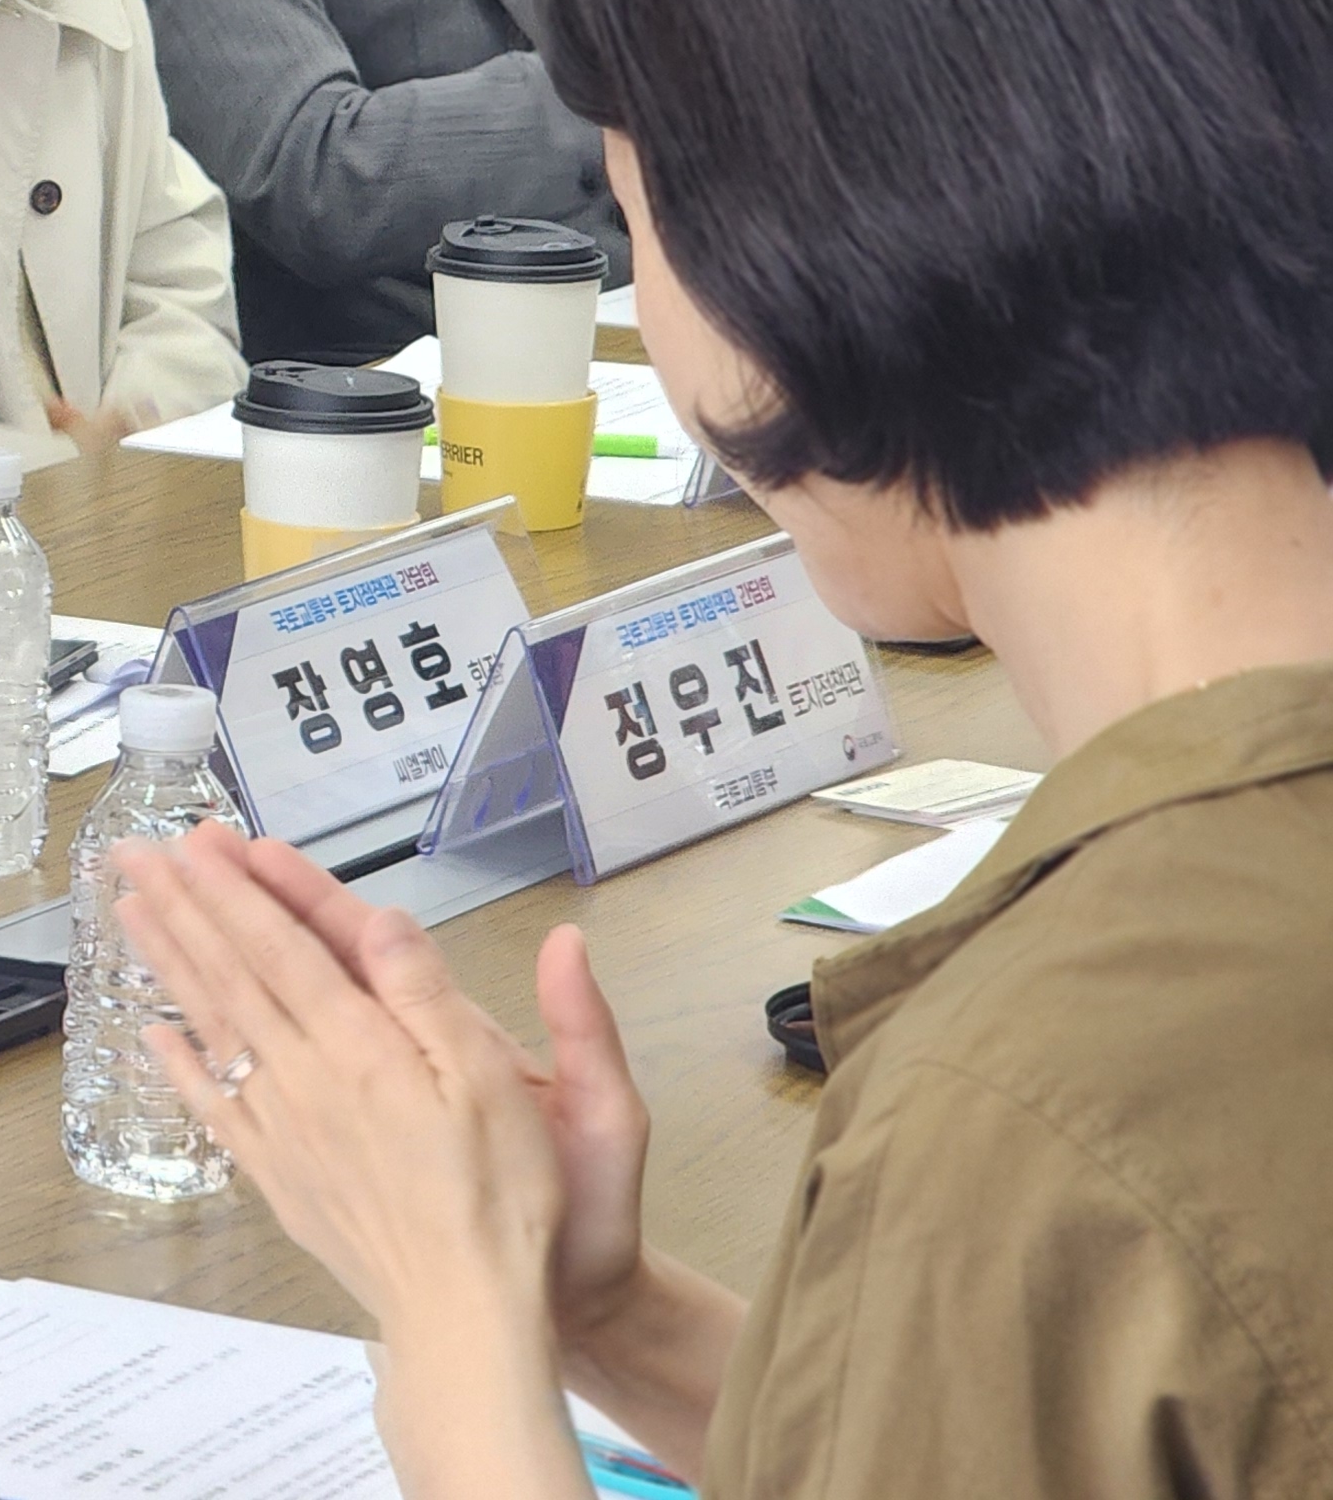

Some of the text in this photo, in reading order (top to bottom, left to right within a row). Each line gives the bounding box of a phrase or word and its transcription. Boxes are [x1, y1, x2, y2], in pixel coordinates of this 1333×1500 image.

[441, 440, 484, 467] ERRIER
[270, 562, 440, 633] 국토교통부 토지정책관 간담회
[615, 575, 776, 649] 국토교통부 토지정책관 간담회
[786, 660, 866, 718] 토지정책관
[711, 765, 779, 810] 국토교통부
